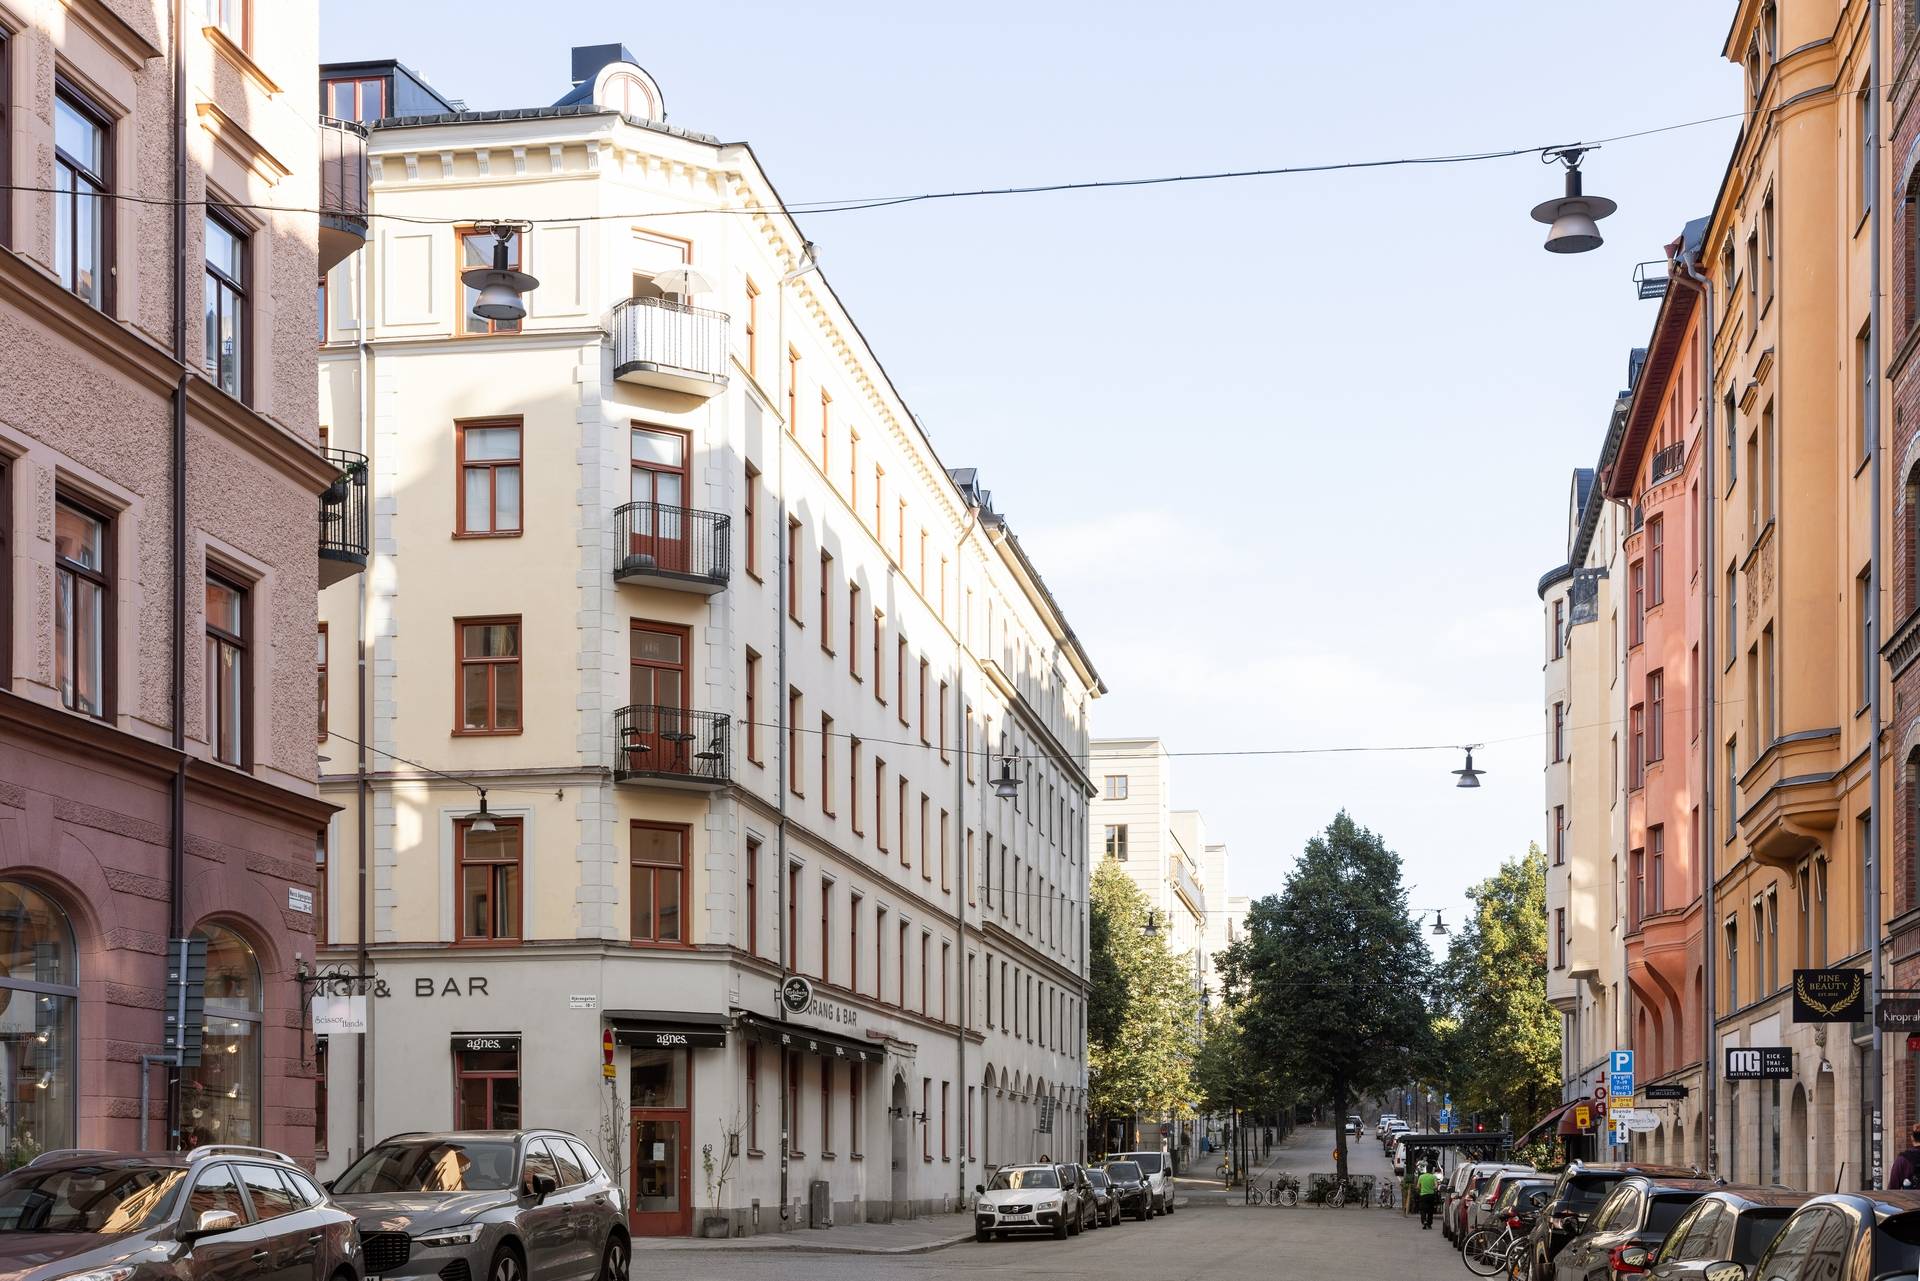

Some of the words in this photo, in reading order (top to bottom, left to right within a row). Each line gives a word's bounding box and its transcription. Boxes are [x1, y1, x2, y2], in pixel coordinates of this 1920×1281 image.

[1818, 974, 1841, 982] PINE
[374, 979, 391, 998] &
[415, 977, 489, 997] BAR
[1809, 982, 1848, 990] BEAUTY
[806, 999, 833, 1020] URANG
[836, 1007, 841, 1022] &
[843, 1009, 857, 1027] BAR
[314, 1015, 343, 1025] Scissor
[466, 1038, 501, 1050] agnes.
[656, 1033, 688, 1046] agnes.
[1616, 1053, 1629, 1071] P
[1730, 1050, 1760, 1072] MG
